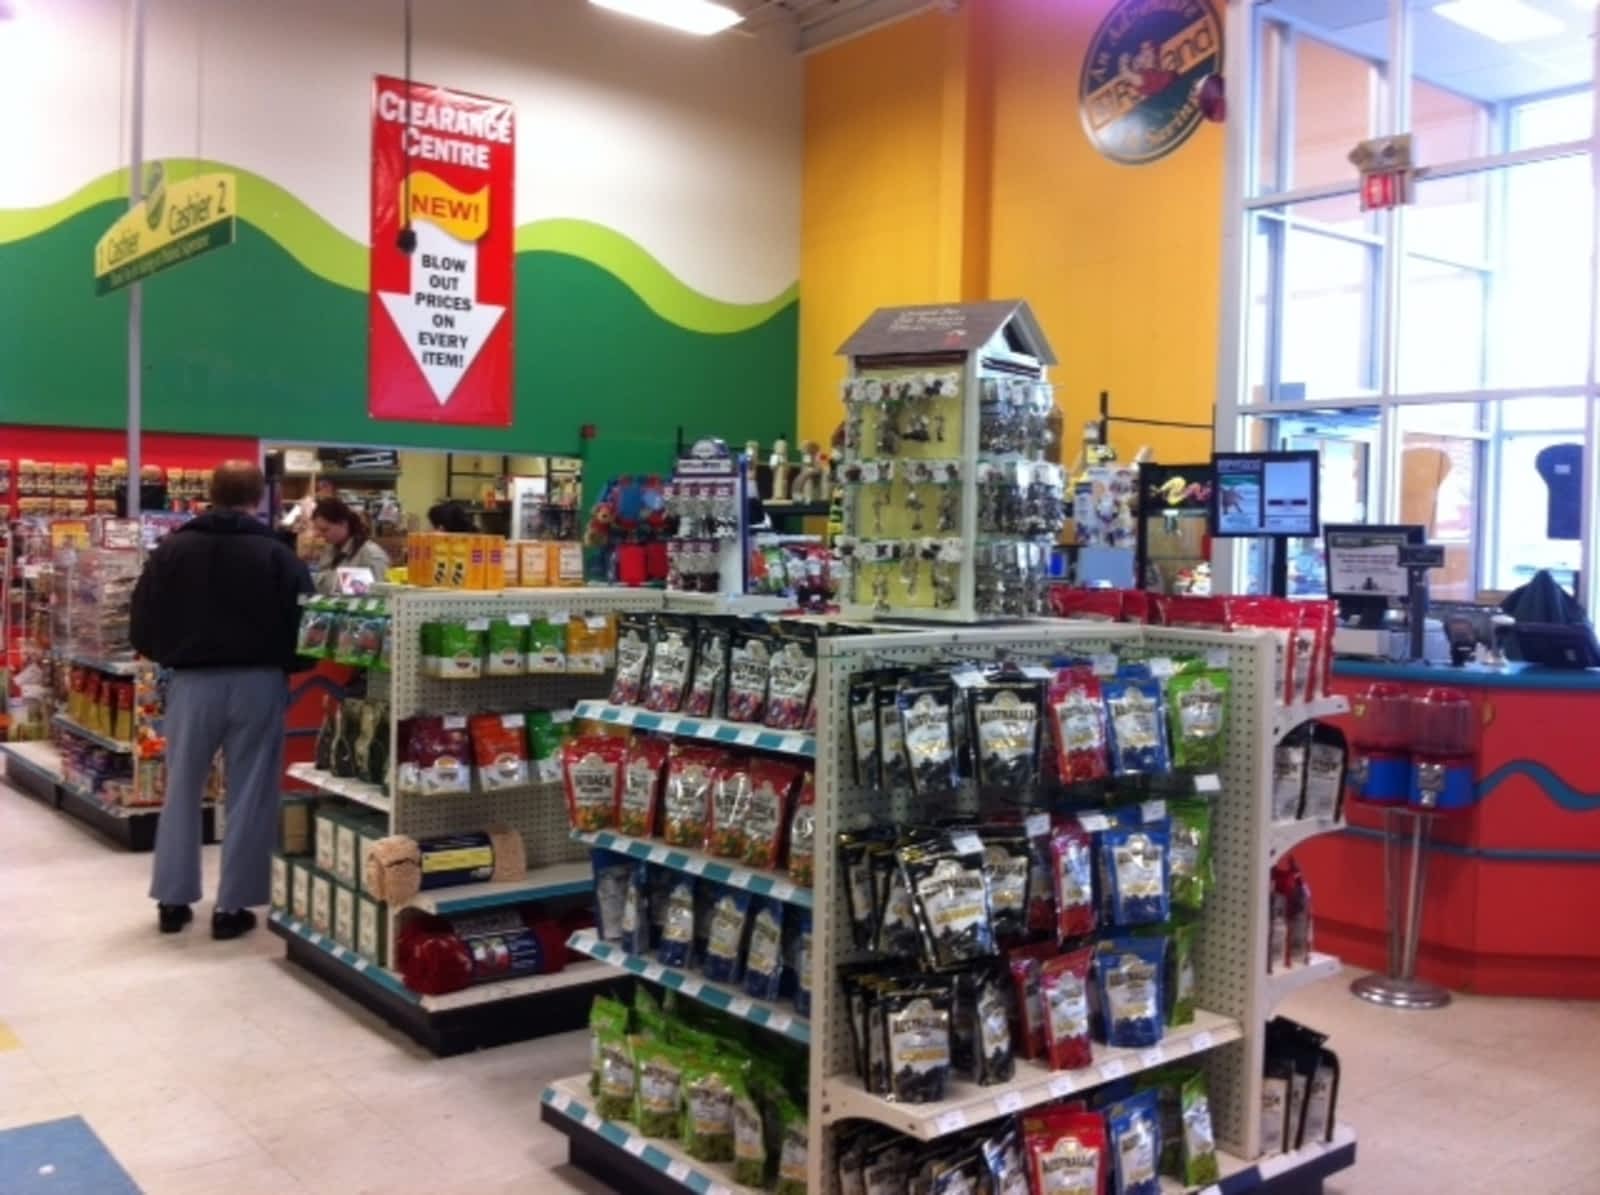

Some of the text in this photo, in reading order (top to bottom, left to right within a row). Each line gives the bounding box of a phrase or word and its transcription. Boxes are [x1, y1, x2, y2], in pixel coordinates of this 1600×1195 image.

[379, 90, 512, 144] CLEARANCE
[402, 127, 491, 170] CENTRE
[168, 180, 227, 235] Cashier 2
[411, 194, 480, 223] NEW!
[422, 254, 467, 273] BLOW
[429, 274, 460, 291] OUT
[415, 292, 472, 312] PRICES
[432, 313, 455, 329] ON
[418, 331, 469, 349] EVERY
[422, 351, 464, 369] ITEM!
